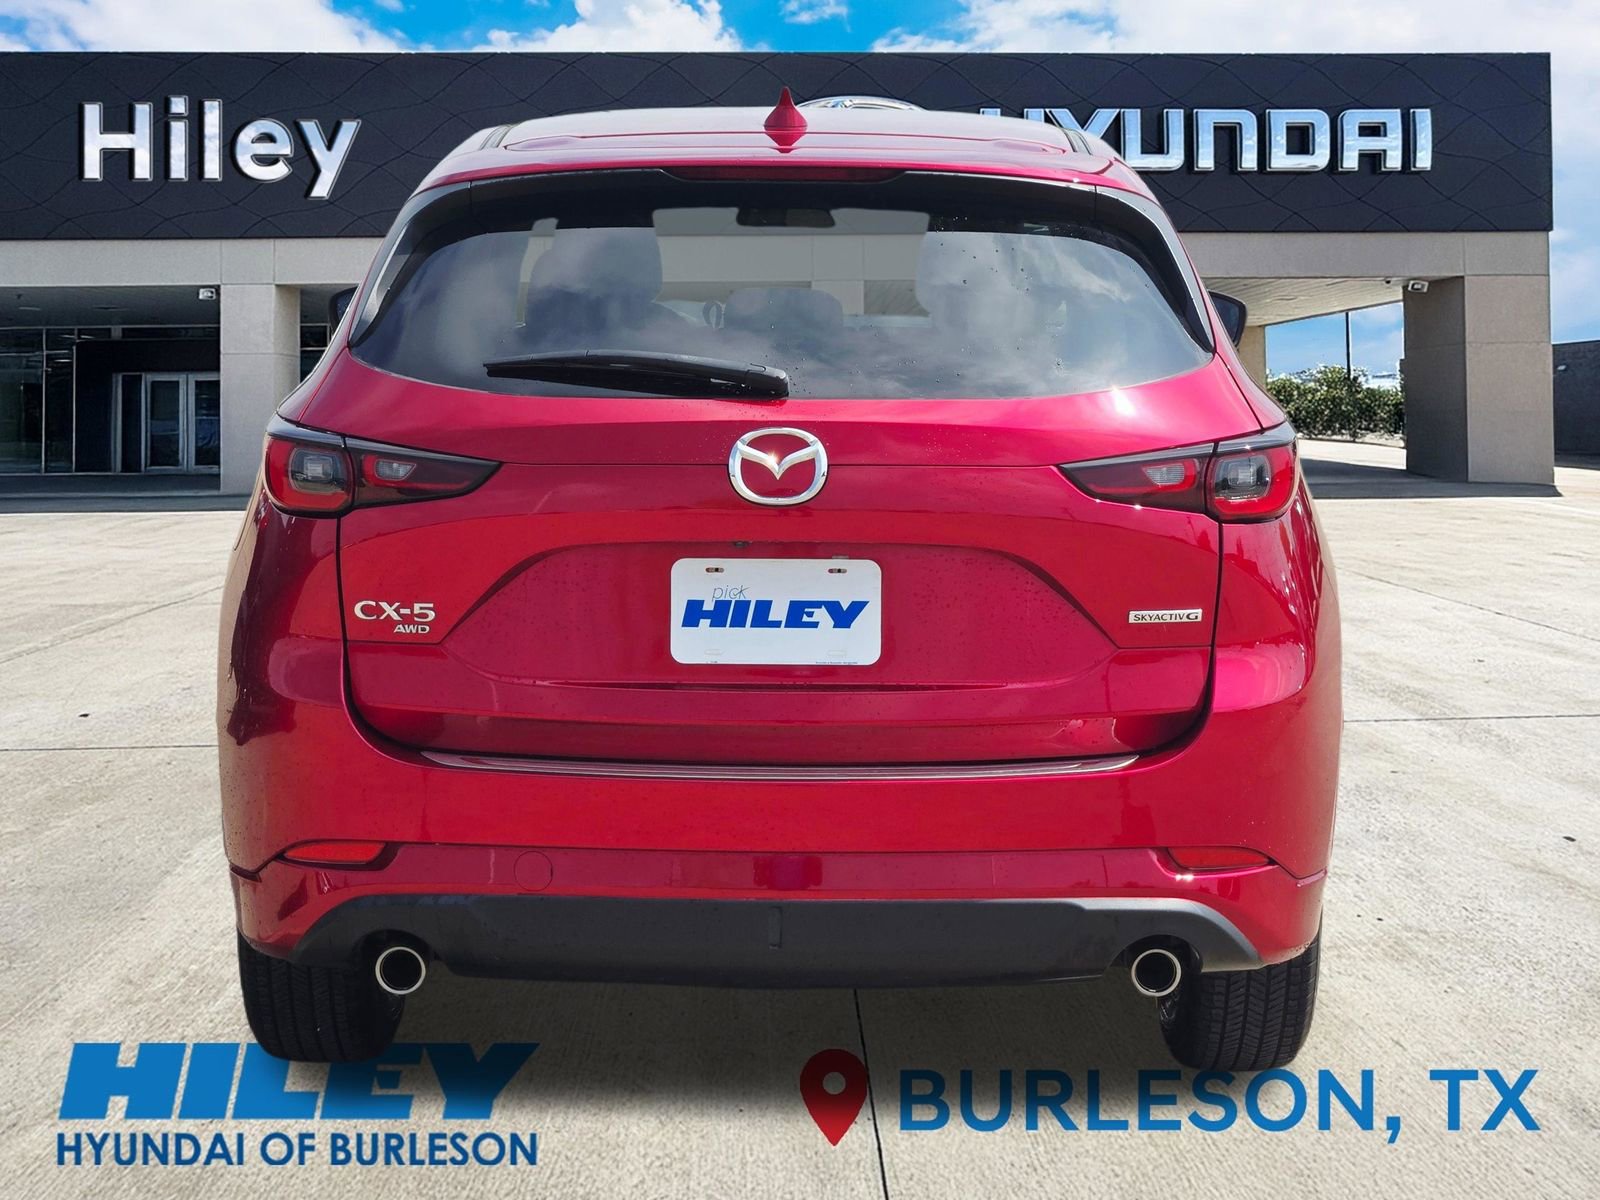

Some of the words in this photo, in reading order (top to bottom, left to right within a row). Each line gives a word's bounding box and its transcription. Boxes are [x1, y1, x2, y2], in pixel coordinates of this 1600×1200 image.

[81, 95, 360, 199] Hiley
[979, 108, 1433, 171] YUNDAI
[354, 600, 436, 622] CX-5
[681, 599, 870, 629] HILEY
[393, 624, 430, 634] AWD
